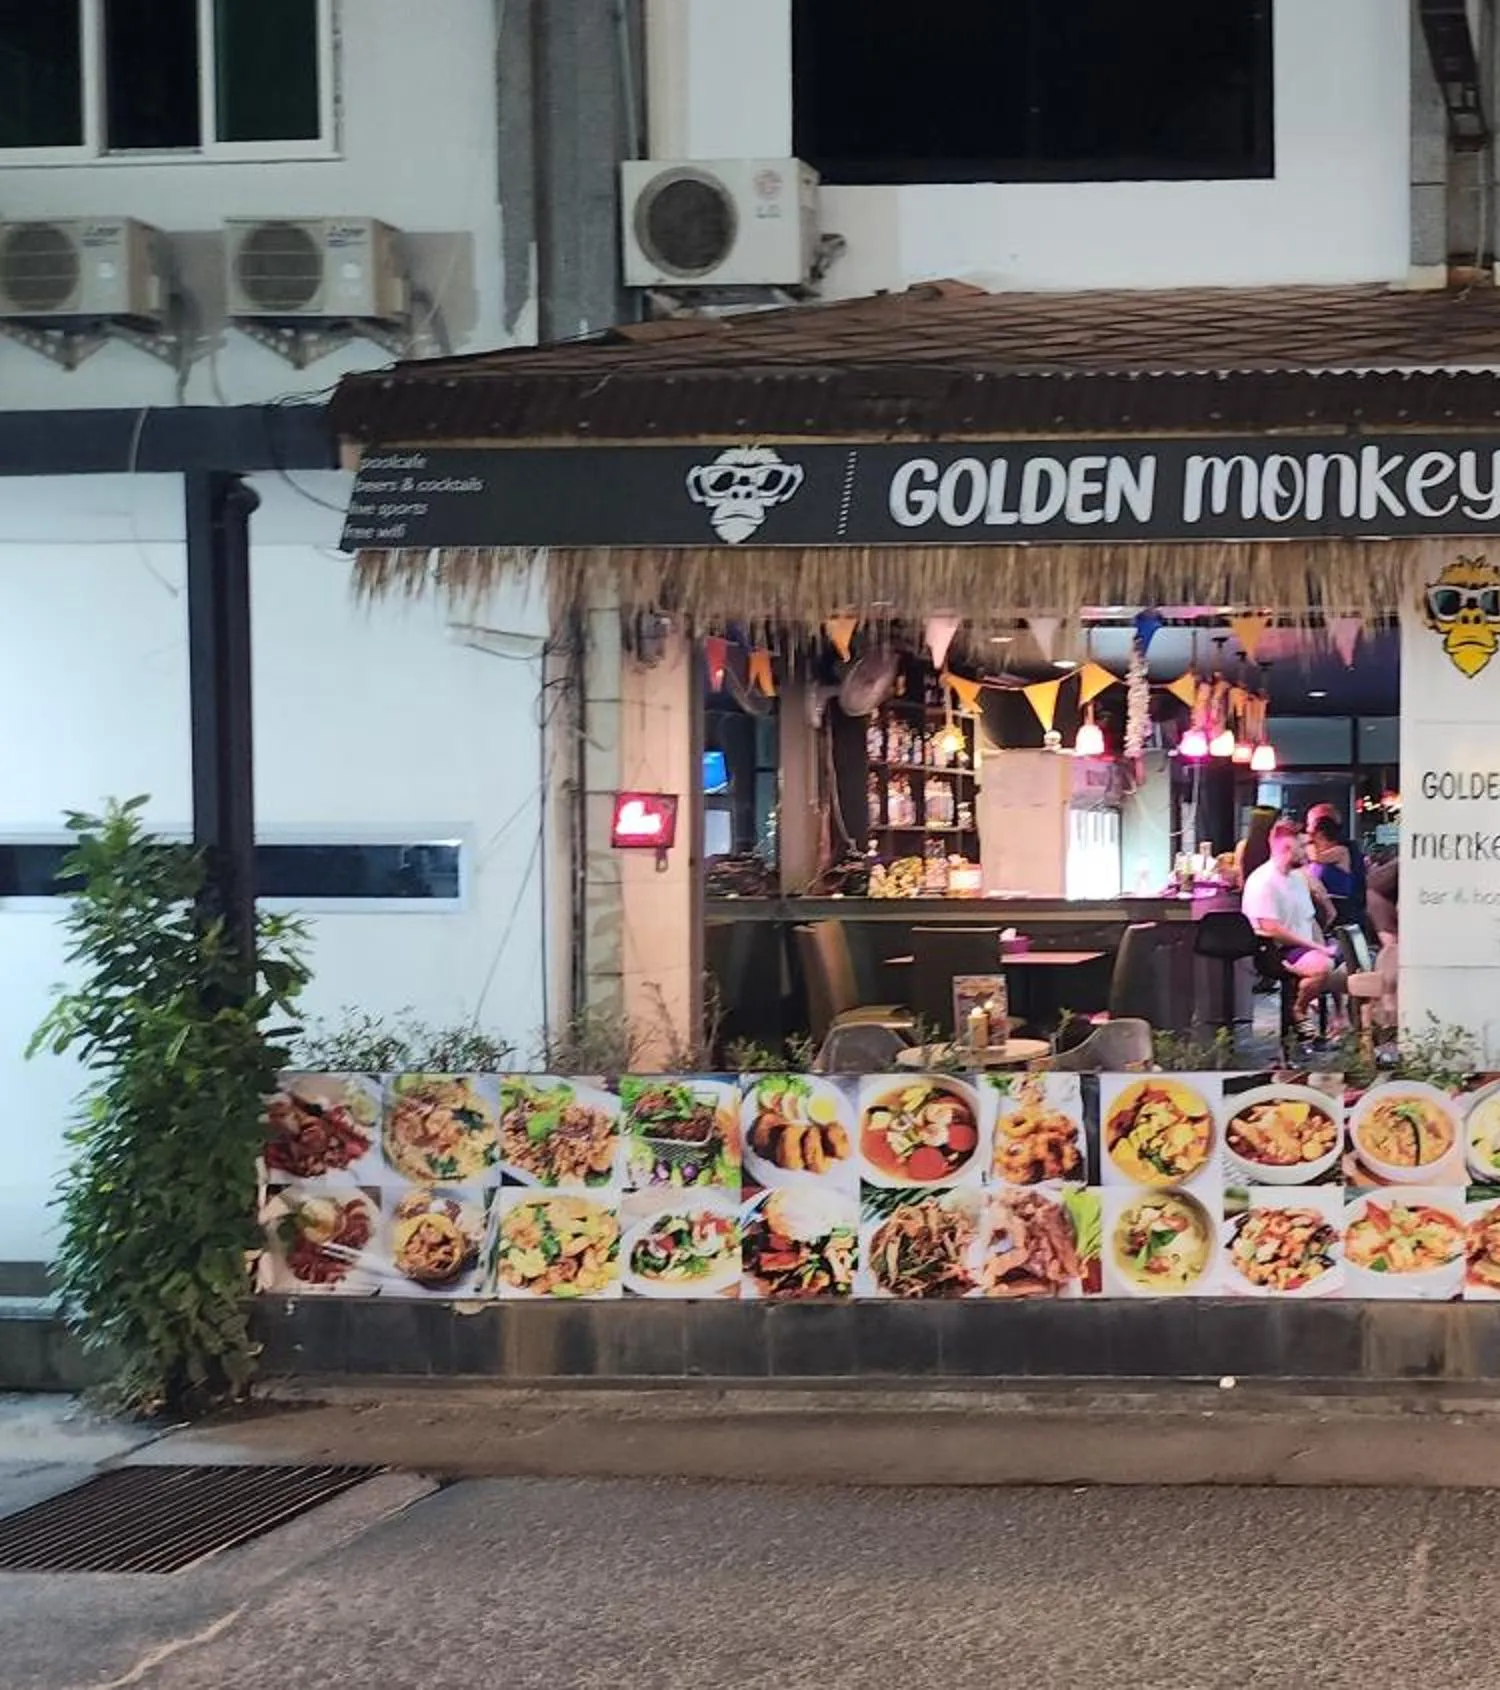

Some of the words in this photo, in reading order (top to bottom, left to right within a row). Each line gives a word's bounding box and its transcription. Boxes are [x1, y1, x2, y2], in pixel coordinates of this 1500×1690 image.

[355, 478, 397, 492] beers
[400, 477, 414, 492] &
[416, 476, 484, 492] cocktails
[888, 455, 1157, 527] GOLDEN
[377, 502, 428, 518] sports
